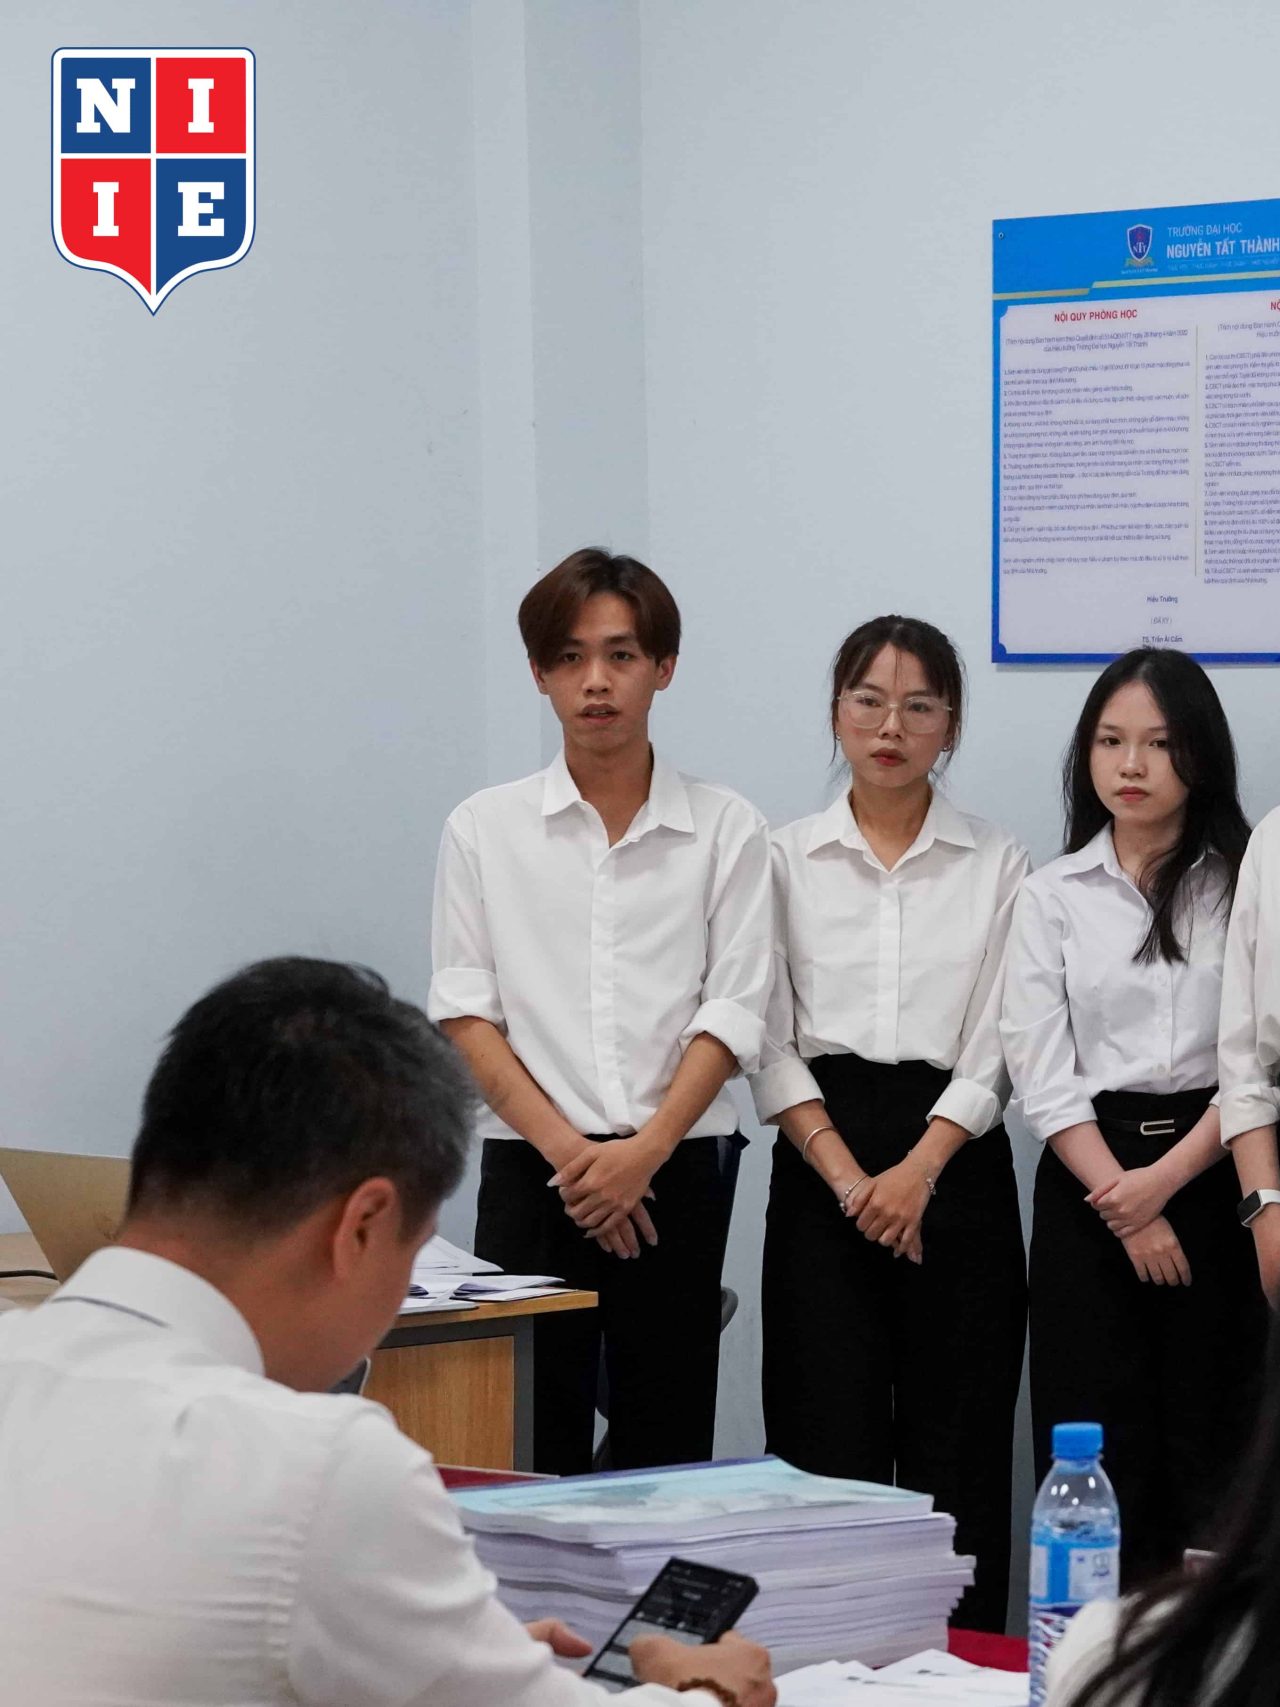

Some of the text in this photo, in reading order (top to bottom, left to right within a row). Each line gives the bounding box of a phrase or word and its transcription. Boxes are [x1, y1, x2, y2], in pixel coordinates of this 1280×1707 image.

[1241, 235, 1280, 253] THÀNH
[1070, 312, 1087, 322] QUY
[1089, 309, 1118, 320] PHÒNG
[1120, 309, 1138, 319] HỌC
